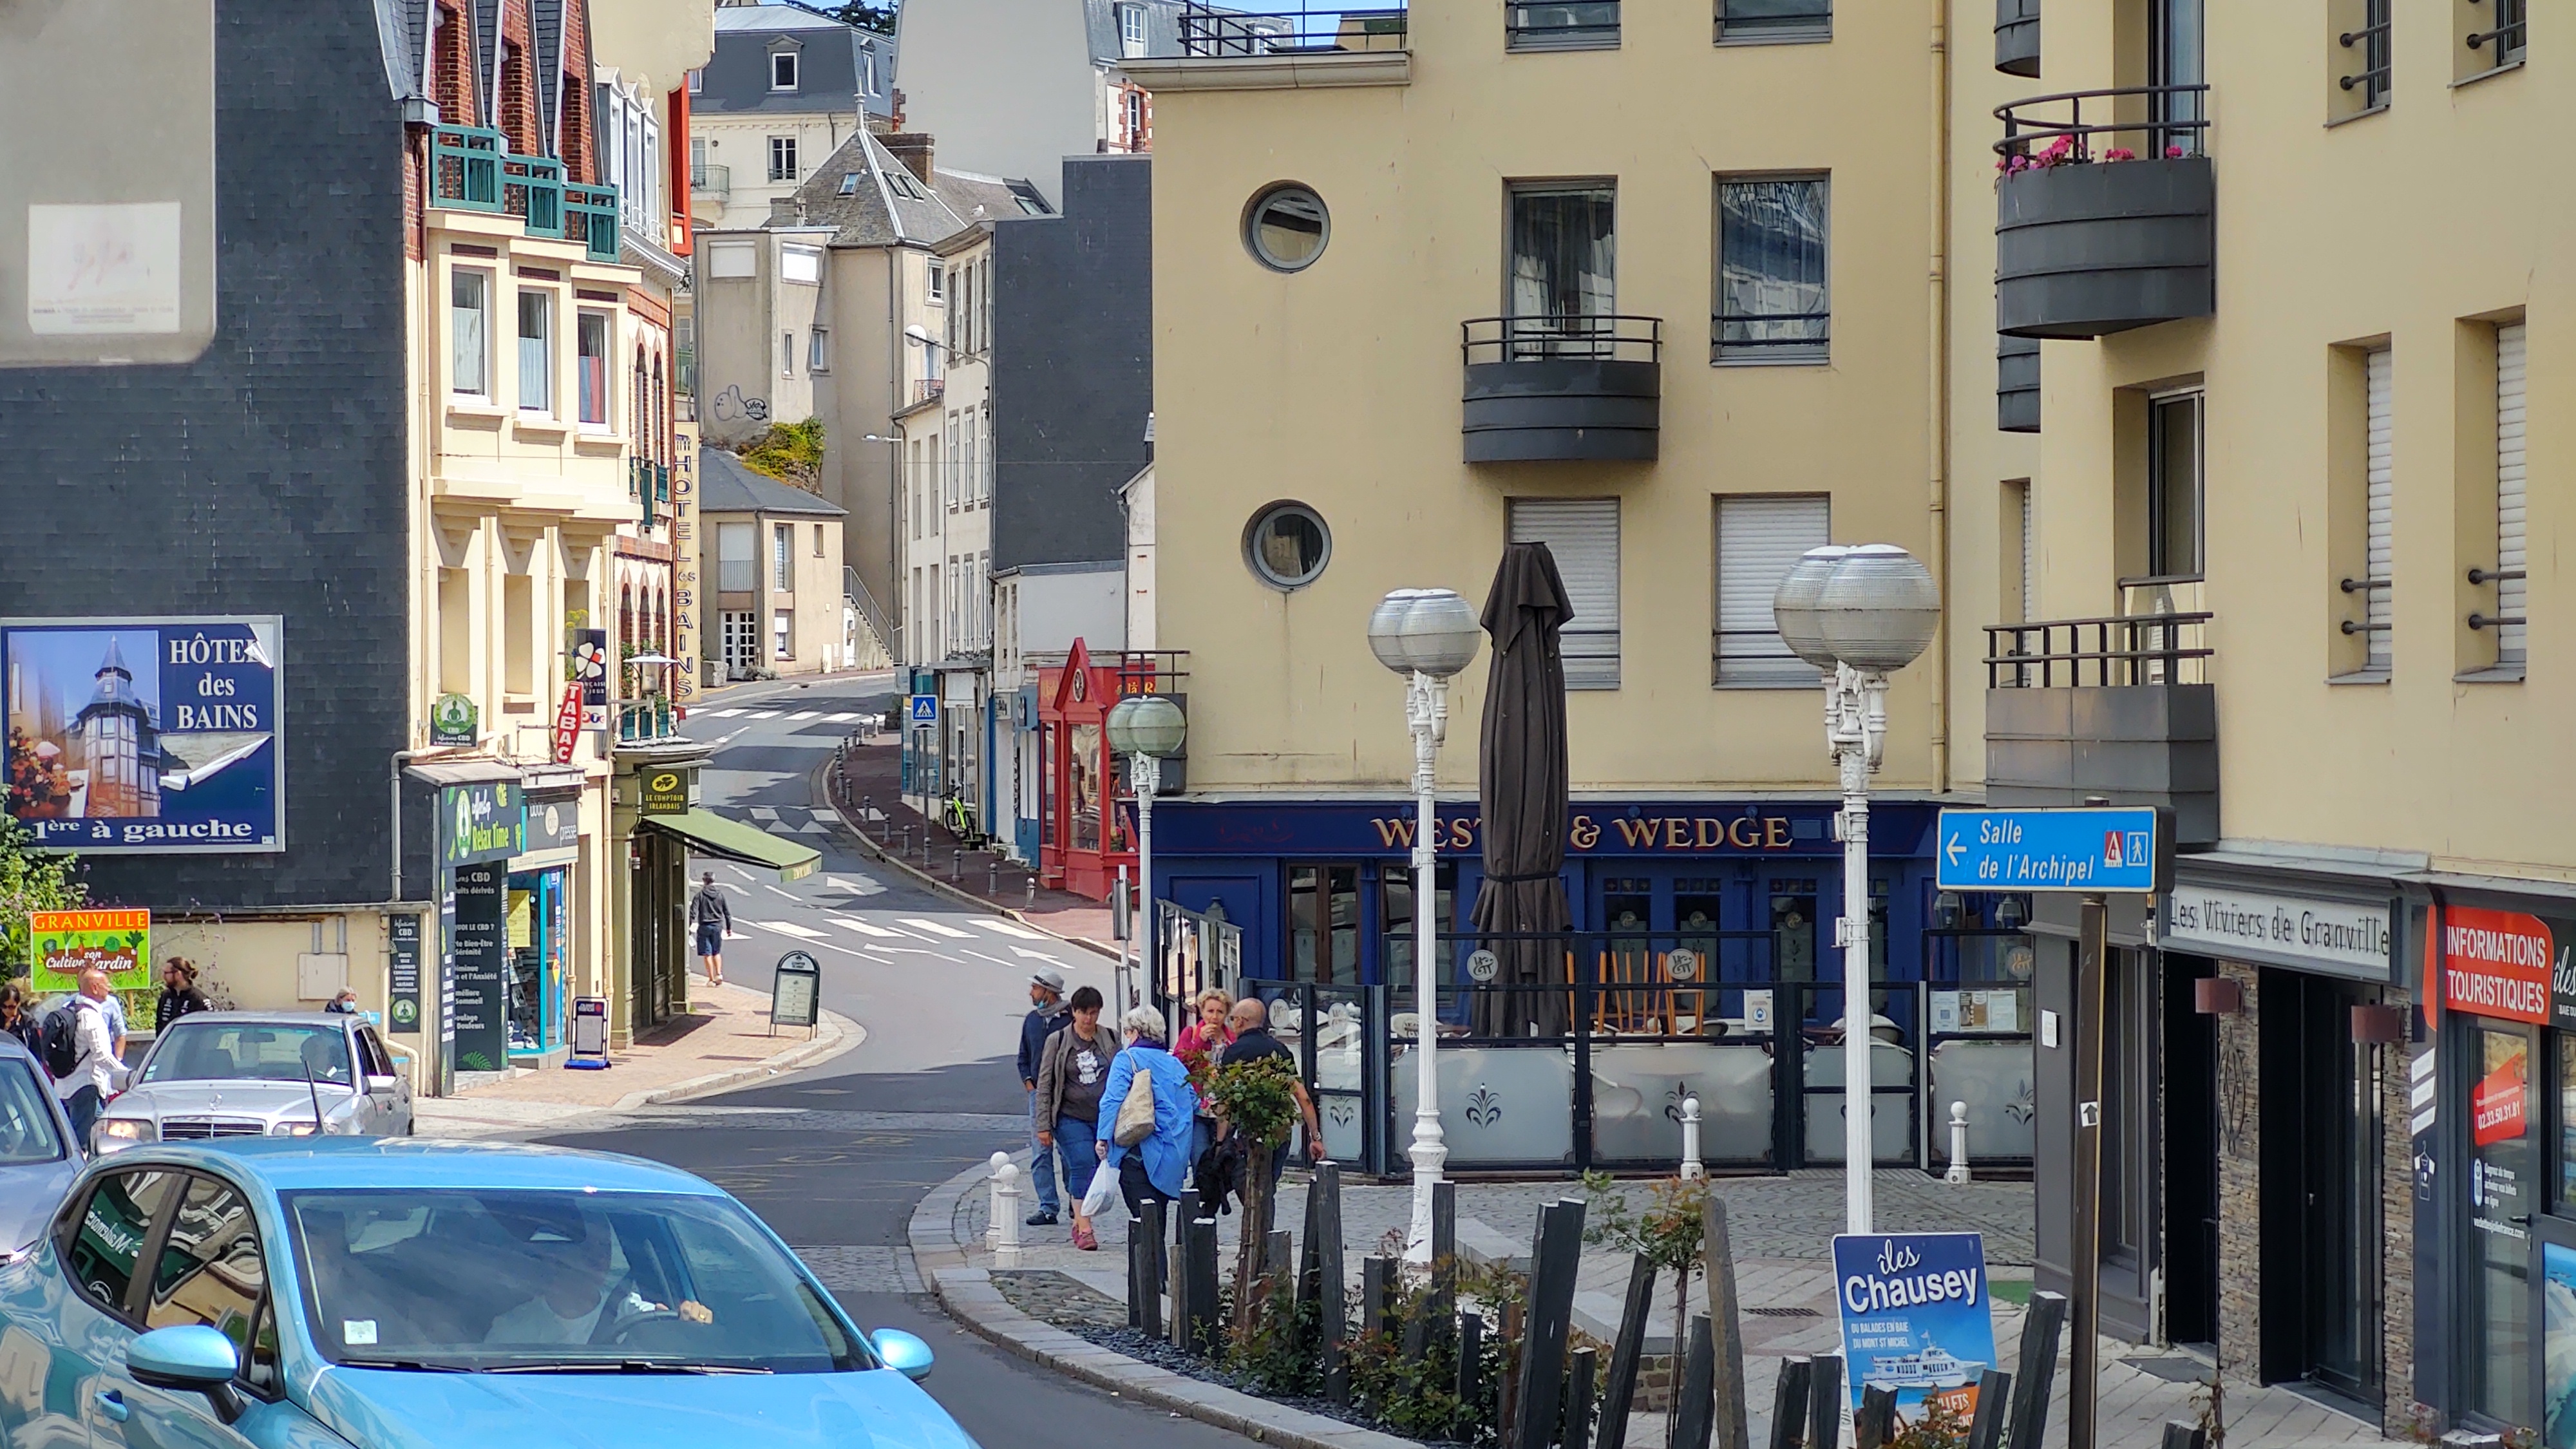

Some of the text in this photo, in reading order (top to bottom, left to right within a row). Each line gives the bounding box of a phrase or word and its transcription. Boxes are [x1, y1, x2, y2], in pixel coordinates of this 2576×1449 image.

[674, 455, 692, 562] HOTEL
[677, 571, 696, 582] es
[676, 589, 694, 697] BAINS
[198, 672, 236, 696] des
[176, 704, 258, 729] BAINS
[557, 685, 580, 760] TABAC
[32, 819, 252, 843] 1ère à gauche
[473, 820, 509, 852] Relax Time
[560, 824, 577, 847] presse
[1370, 815, 1794, 849] WES & WEDGE
[1980, 819, 2022, 844] Salle
[471, 872, 491, 882] CBD
[1979, 853, 2094, 886] de l'Archipel
[470, 886, 495, 895] dérivés
[33, 913, 146, 929] GRANVILLE
[398, 928, 412, 936] CBD
[2170, 896, 2389, 956] Les Viviers de Granville
[455, 948, 482, 956] Sérénité
[464, 938, 493, 947] Bien-Être
[2447, 925, 2546, 969] INFORMATIONS
[91, 955, 133, 970] ardin
[2553, 945, 2576, 996] îles
[455, 989, 480, 997] méliore
[455, 997, 483, 1005] Sommeil
[2448, 969, 2544, 1015] TOURISTIQUES
[455, 1014, 478, 1023] oulage
[2558, 1004, 2570, 1016] BAIE
[2478, 1100, 2521, 1130] 02.33.50.31.81
[1877, 1238, 1920, 1275] îles
[1845, 1267, 1977, 1312] Chausey
[1851, 1321, 1909, 1334] OU BALADES EN BAIE
[1853, 1336, 1910, 1349] DU MONT ST MICHEL
